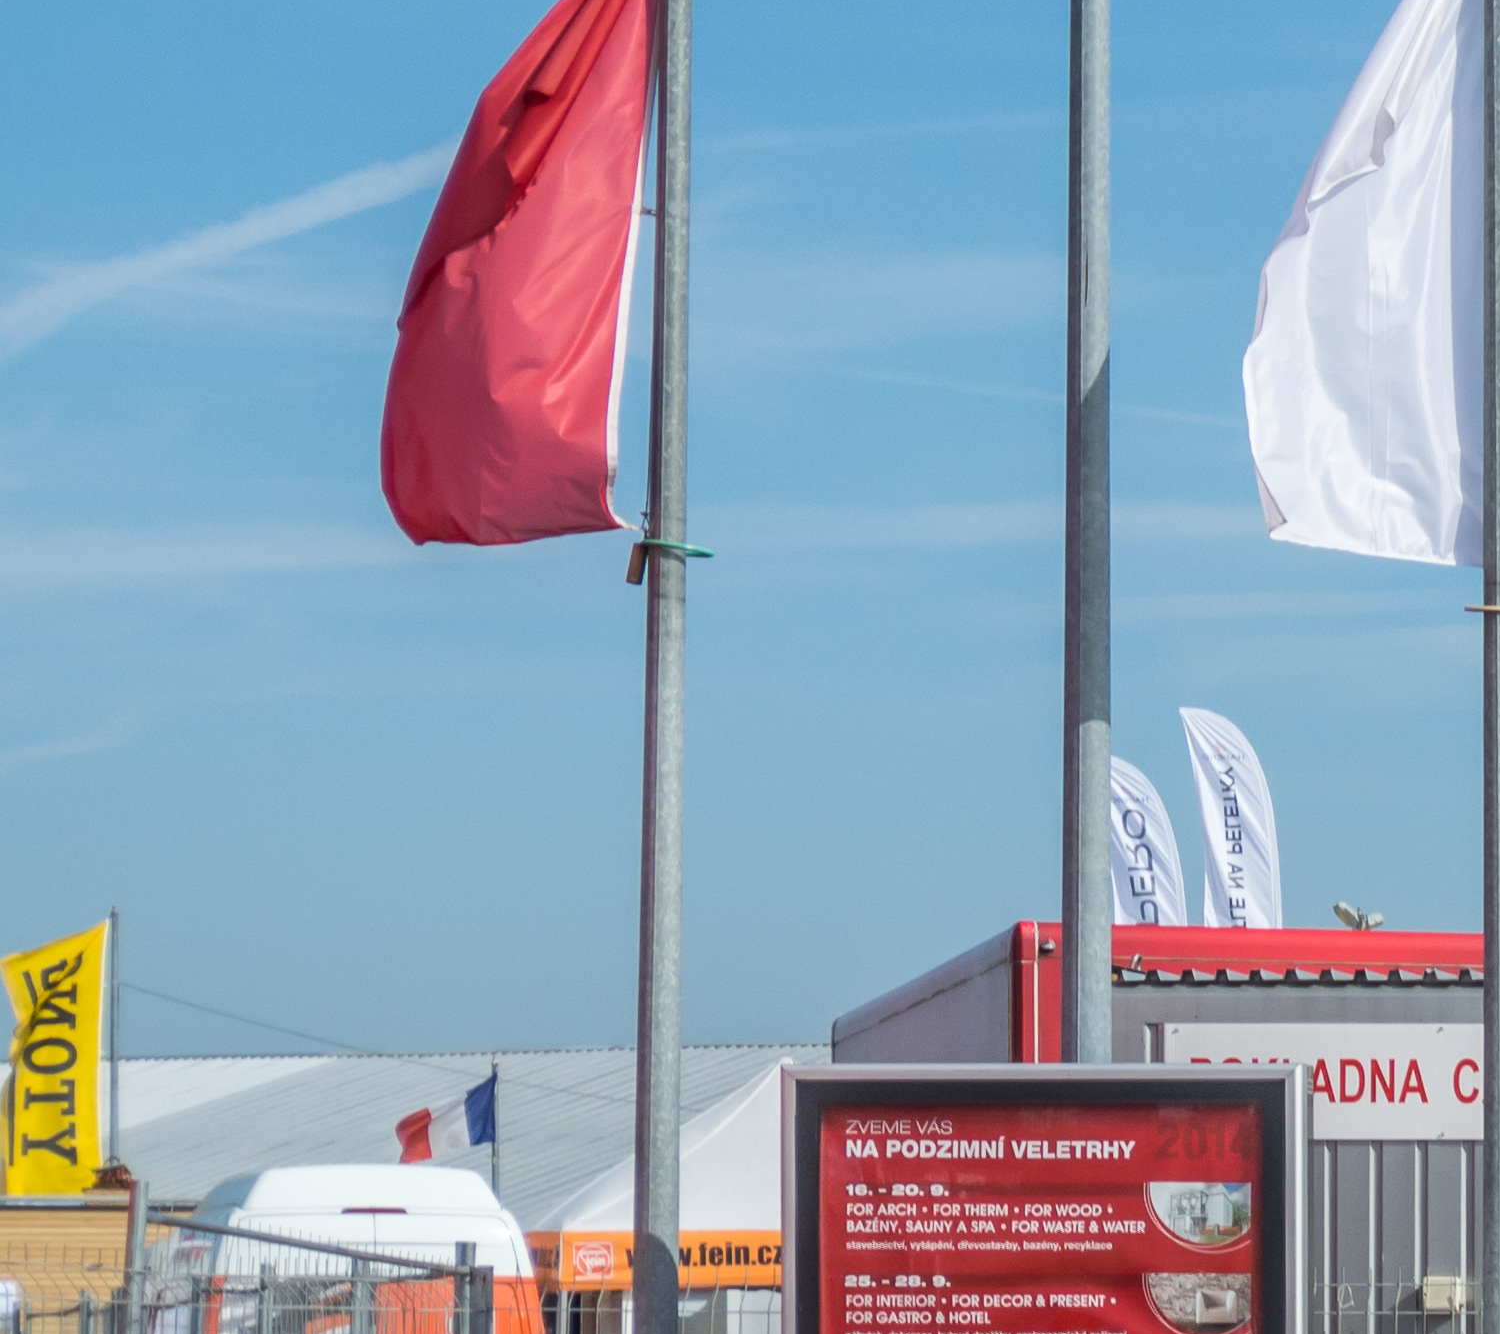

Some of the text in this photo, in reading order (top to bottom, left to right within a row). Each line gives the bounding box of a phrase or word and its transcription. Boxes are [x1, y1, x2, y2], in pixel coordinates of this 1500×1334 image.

[1190, 1057, 1429, 1106] ADNA
[845, 1118, 953, 1135] ZVEME VÁS
[846, 1136, 1136, 1159] NA PODZIMNÍ VELETRHY
[846, 1203, 1102, 1217] FOR ARCH FOR THERM FOR WOOD
[846, 1216, 1146, 1233] BAZÉNY, SAUNY A SPA FOR WASTE & WATER
[846, 1295, 1106, 1307] FOR INTERIOR FOR DECOR & PRESENT
[846, 1311, 991, 1324] FOR GASTRO & HOTEL
